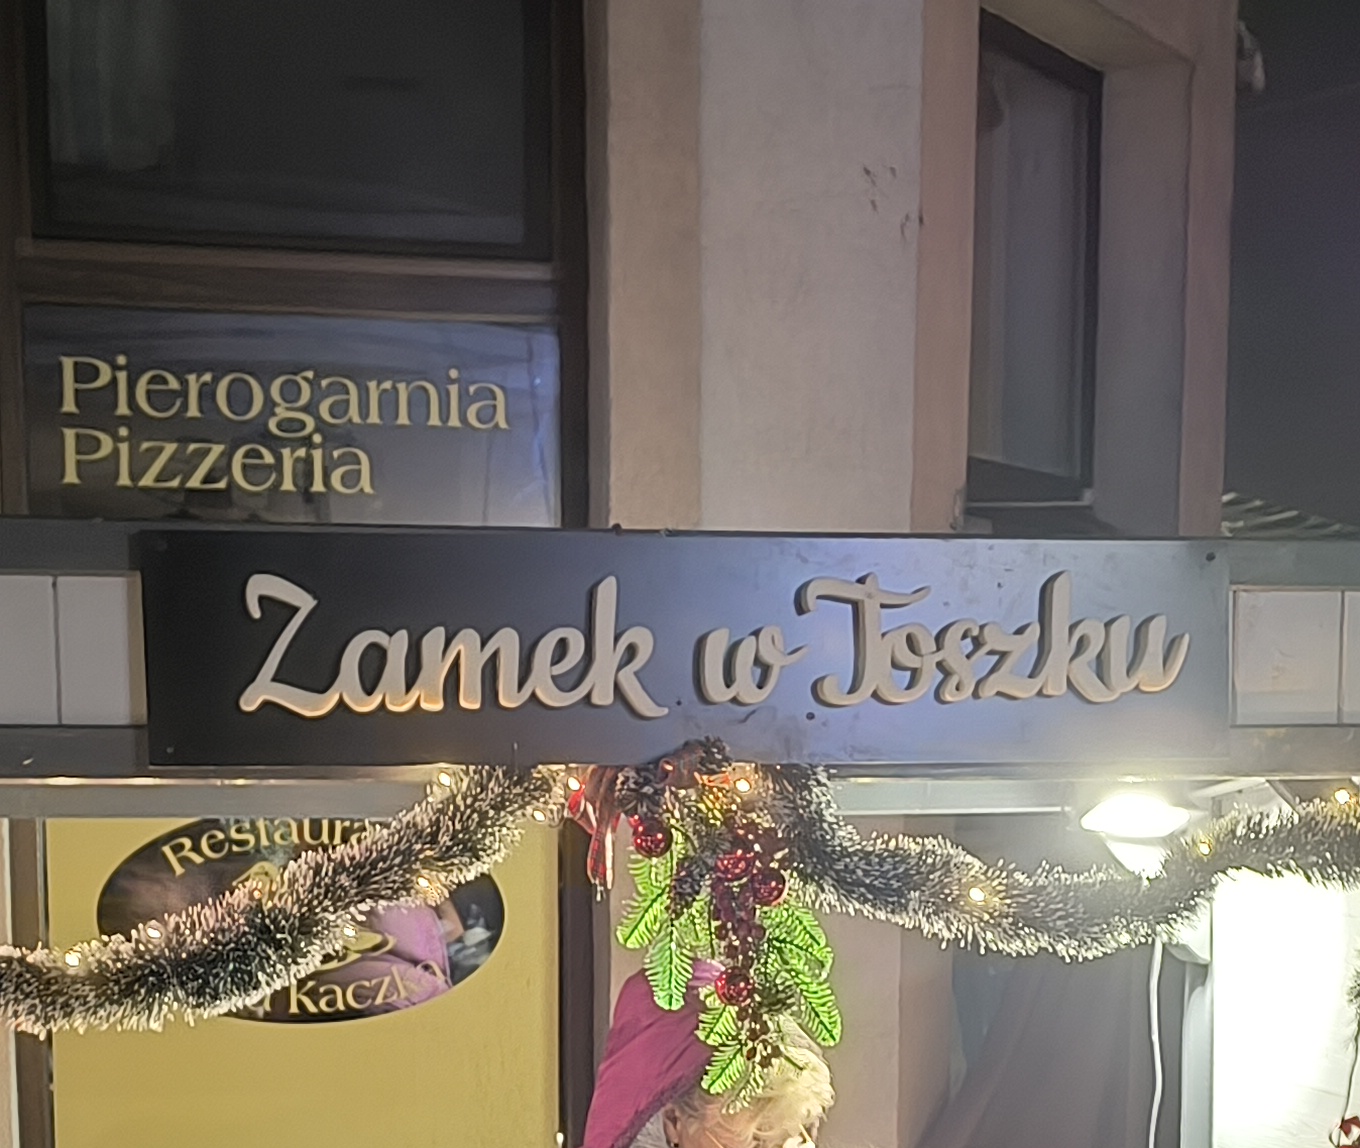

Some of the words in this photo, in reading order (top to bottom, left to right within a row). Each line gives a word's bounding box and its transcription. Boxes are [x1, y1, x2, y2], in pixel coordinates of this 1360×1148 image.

[58, 354, 510, 439] Pierogarnia
[60, 426, 376, 494] Pizzeria
[239, 572, 669, 719] Zamek
[692, 625, 809, 706] w
[794, 569, 1191, 707] Toszku
